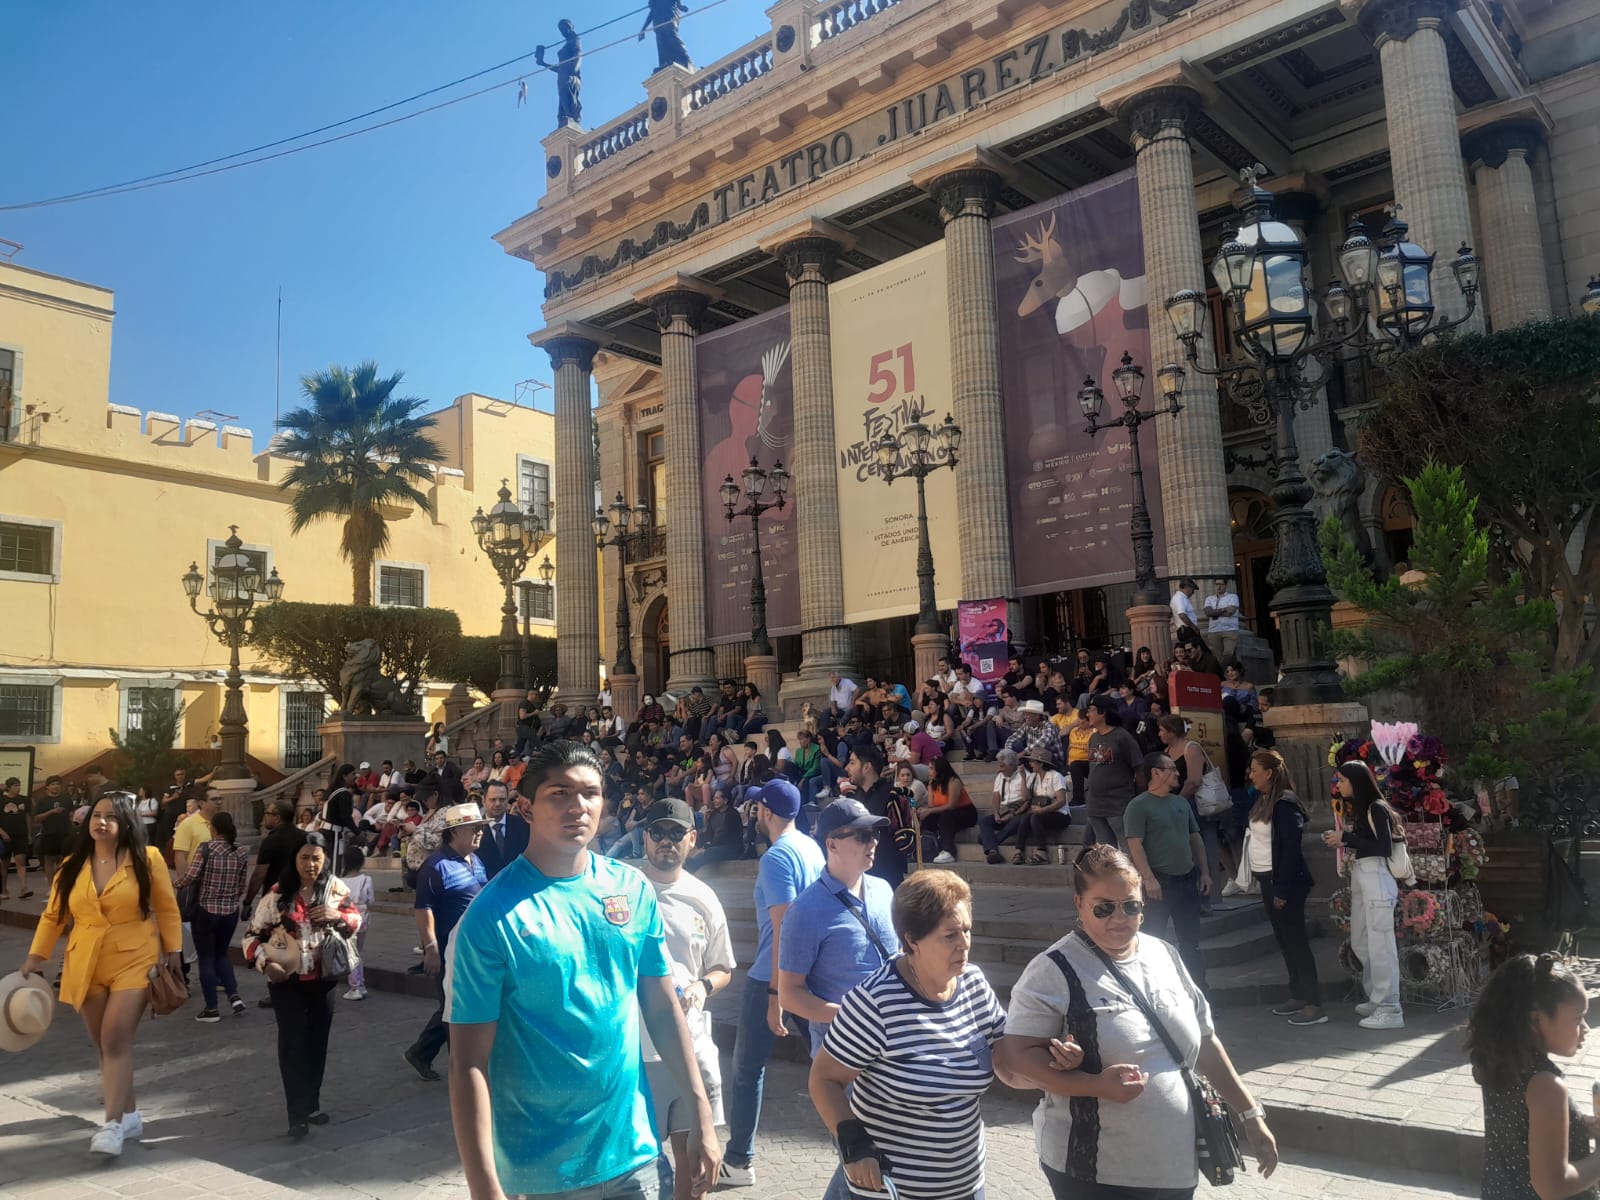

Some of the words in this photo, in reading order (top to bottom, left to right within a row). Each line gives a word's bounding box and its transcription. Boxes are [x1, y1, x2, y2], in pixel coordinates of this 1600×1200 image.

[713, 131, 852, 223] TEATRO
[878, 34, 1054, 146] JUAREZ
[866, 341, 915, 404] 51
[863, 394, 936, 441] FESTIVAL
[884, 513, 914, 524] SONORA
[874, 530, 902, 541] ESTADOS
[1198, 722, 1208, 739] 51
